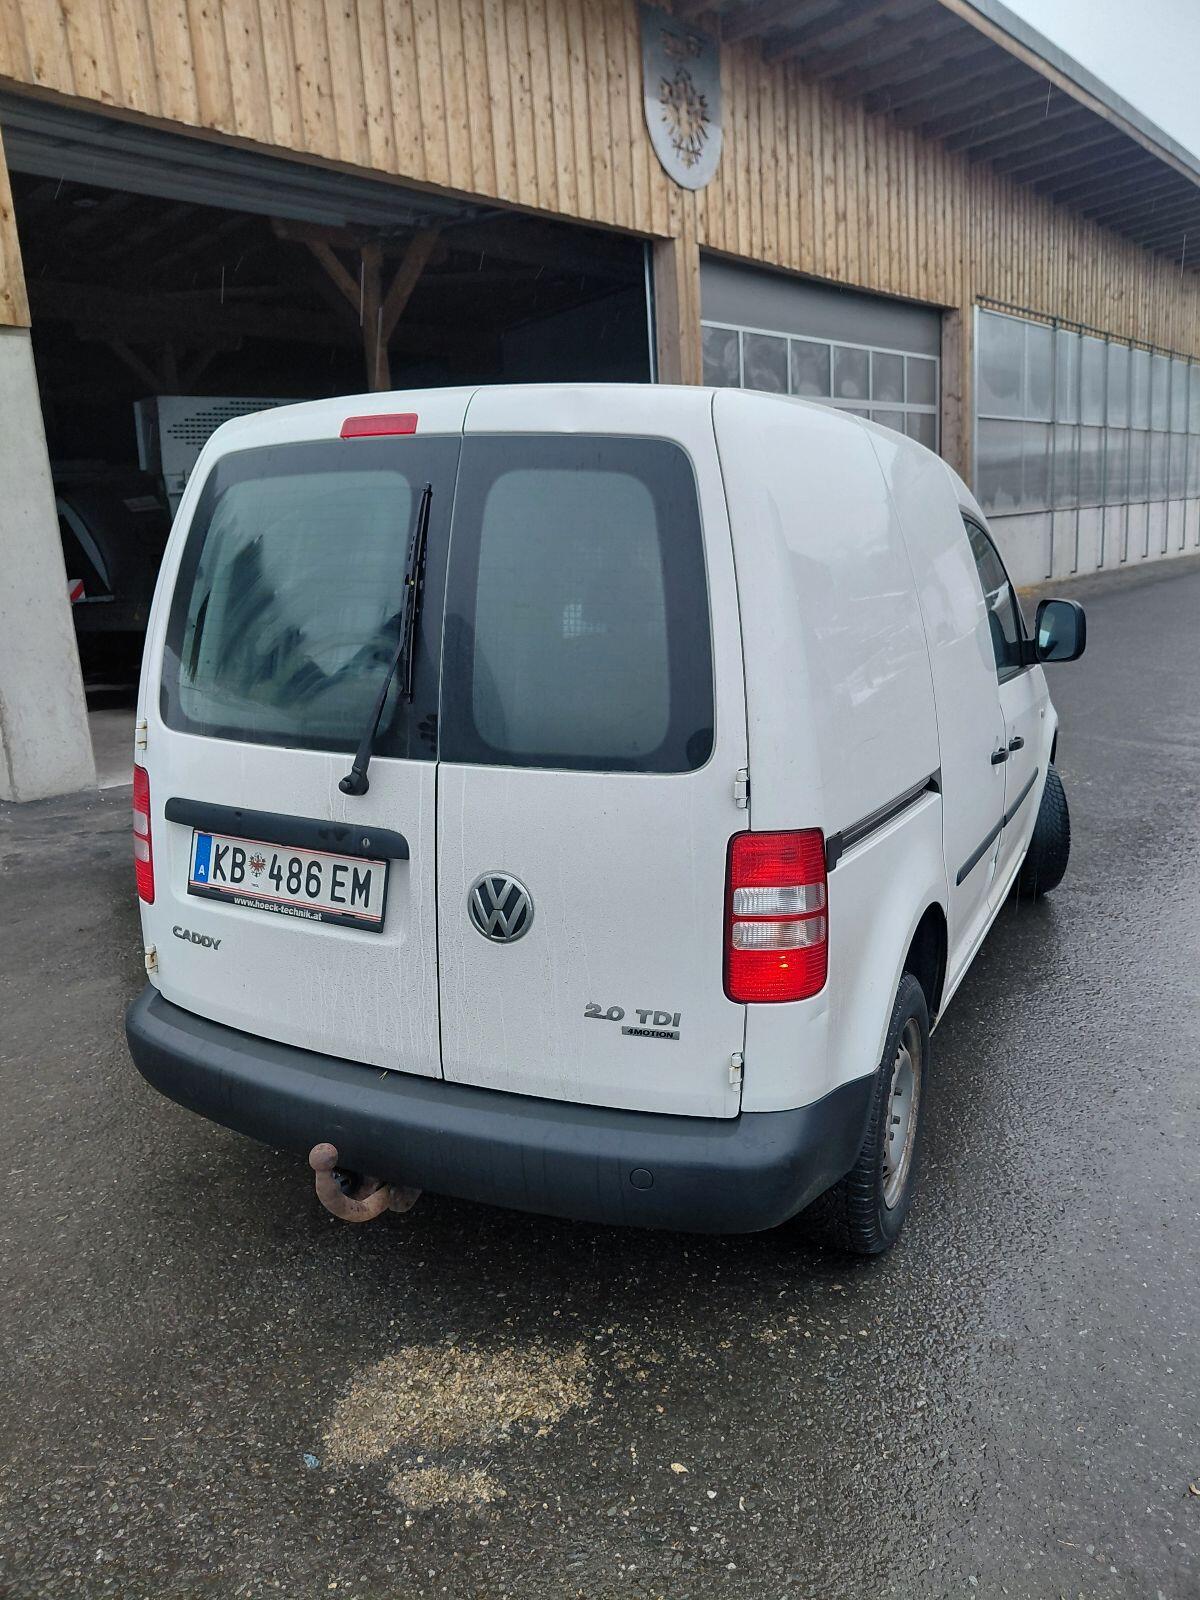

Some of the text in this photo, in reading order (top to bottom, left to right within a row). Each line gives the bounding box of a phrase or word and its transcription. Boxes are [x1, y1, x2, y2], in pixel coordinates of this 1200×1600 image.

[198, 866, 205, 876] A
[212, 843, 372, 908] KB 486 EM
[234, 896, 323, 921] www.hoeck-technik.at
[471, 876, 530, 939] VW
[172, 925, 222, 950] CADDY
[635, 1009, 681, 1027] TDI
[627, 1028, 674, 1039] 4MOTION
